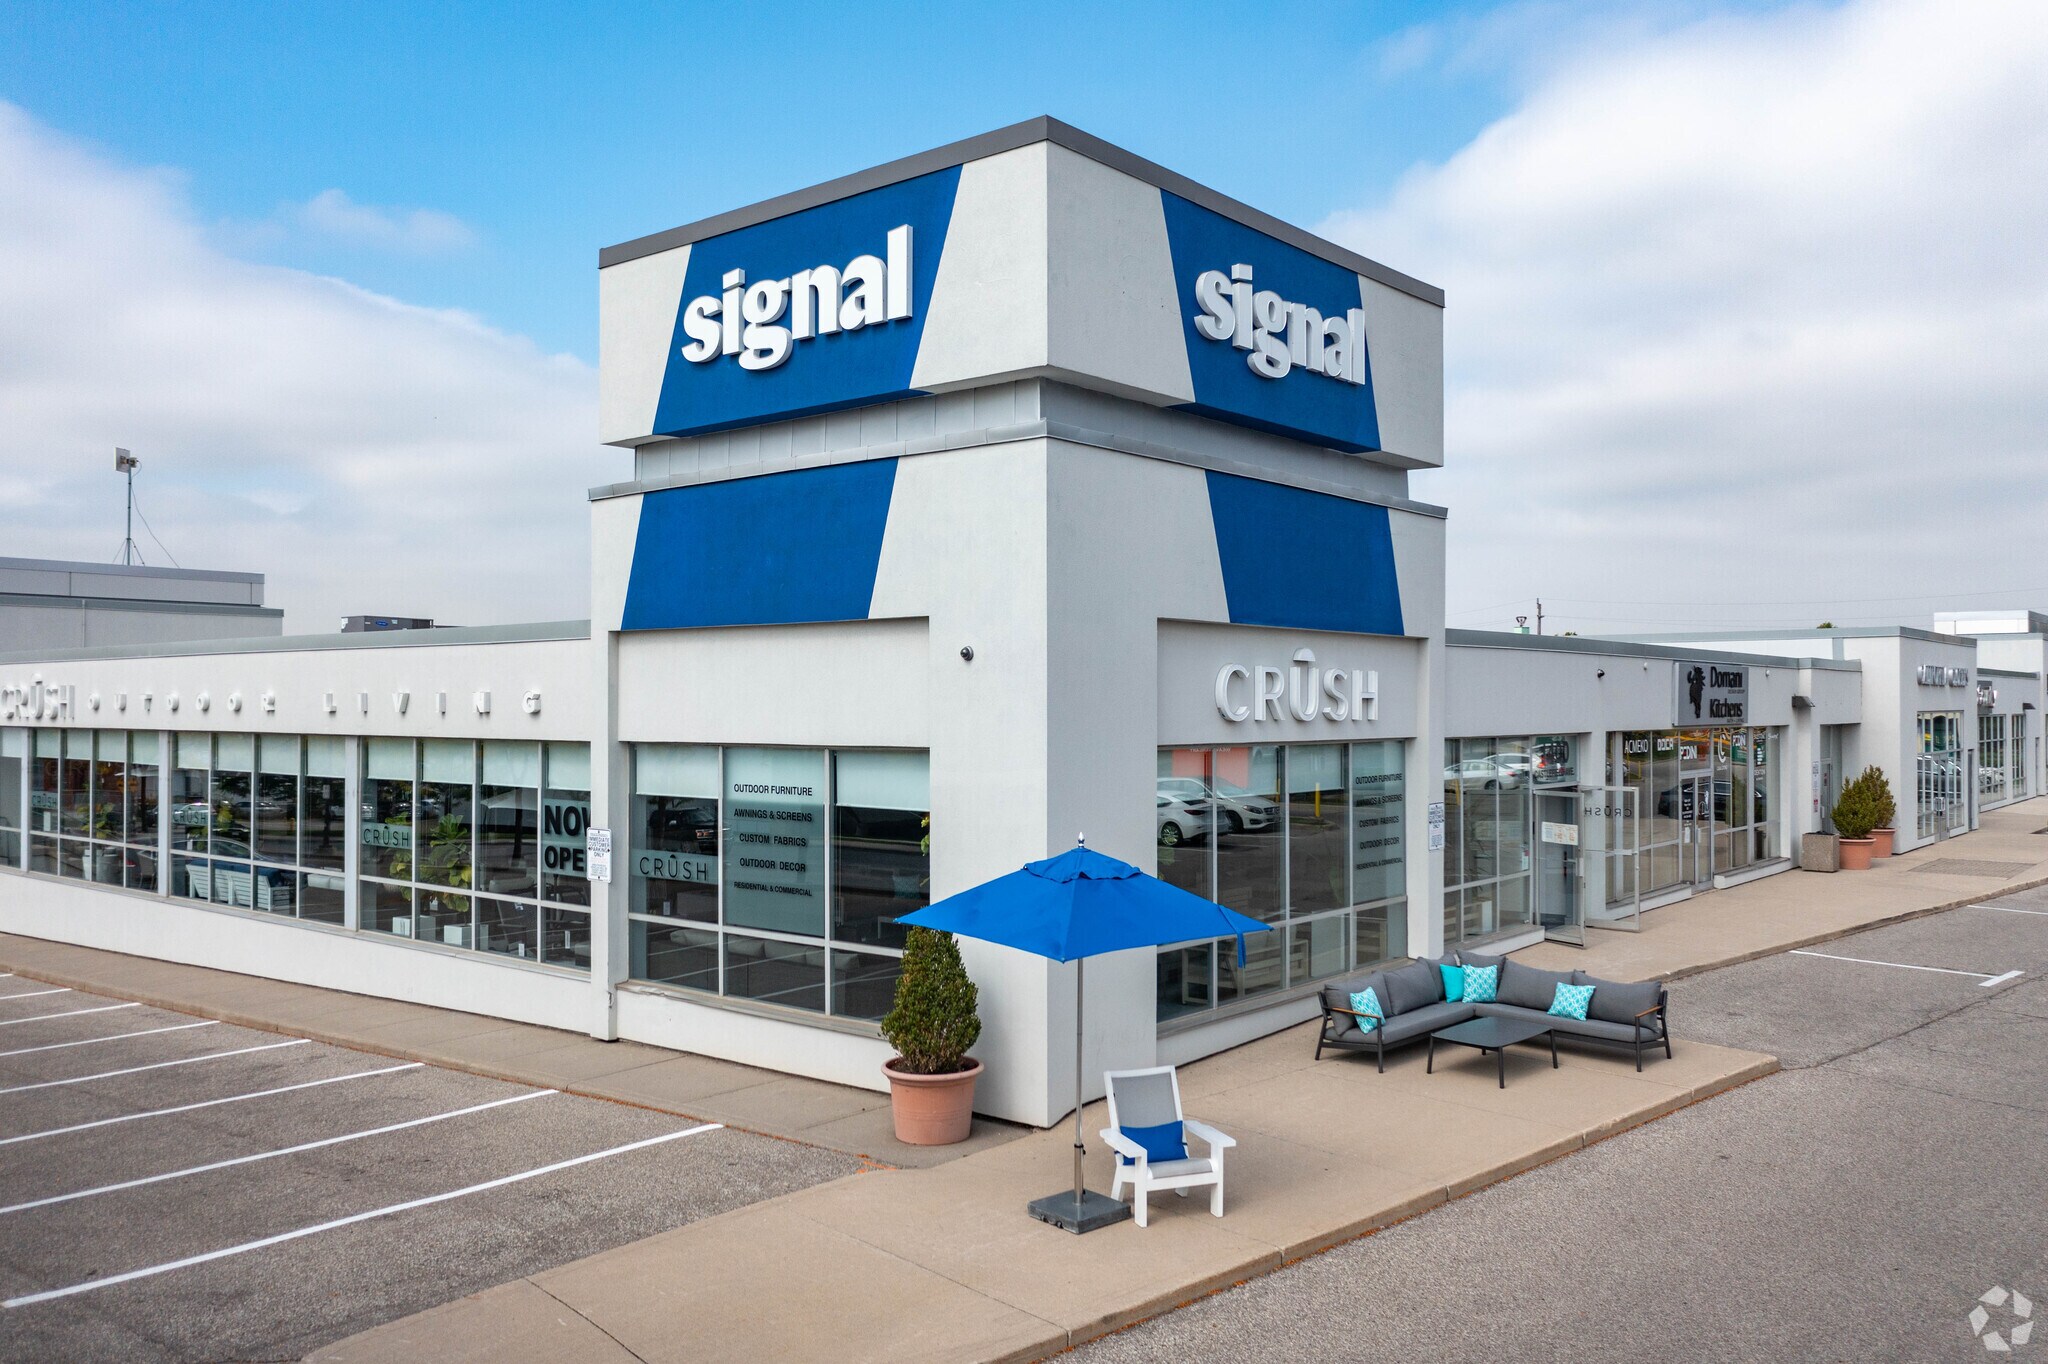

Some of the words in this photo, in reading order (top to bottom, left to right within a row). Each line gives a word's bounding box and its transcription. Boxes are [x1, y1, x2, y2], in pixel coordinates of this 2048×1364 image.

[681, 223, 913, 370] signal
[1194, 263, 1366, 386] signal
[1710, 666, 1743, 688] Domani
[88, 692, 275, 714] OUTDOOR
[323, 688, 541, 714] LIVING
[1709, 698, 1743, 718] Kitchens
[1356, 774, 1378, 784] OUTDOOR
[734, 784, 769, 794] OUTDOOR
[771, 785, 812, 796] FURNITURE
[734, 808, 768, 819] AWNINGS
[769, 810, 775, 819] &
[776, 811, 813, 822] SCREENS
[739, 833, 770, 844] CUSTOM
[774, 836, 807, 847] FABRICS
[544, 845, 584, 872] OPE
[740, 858, 776, 869] OUTDOOR
[779, 861, 806, 873] DECOR
[734, 881, 768, 892] RESIDENTIAL
[774, 886, 812, 897] COMMERCIAL
